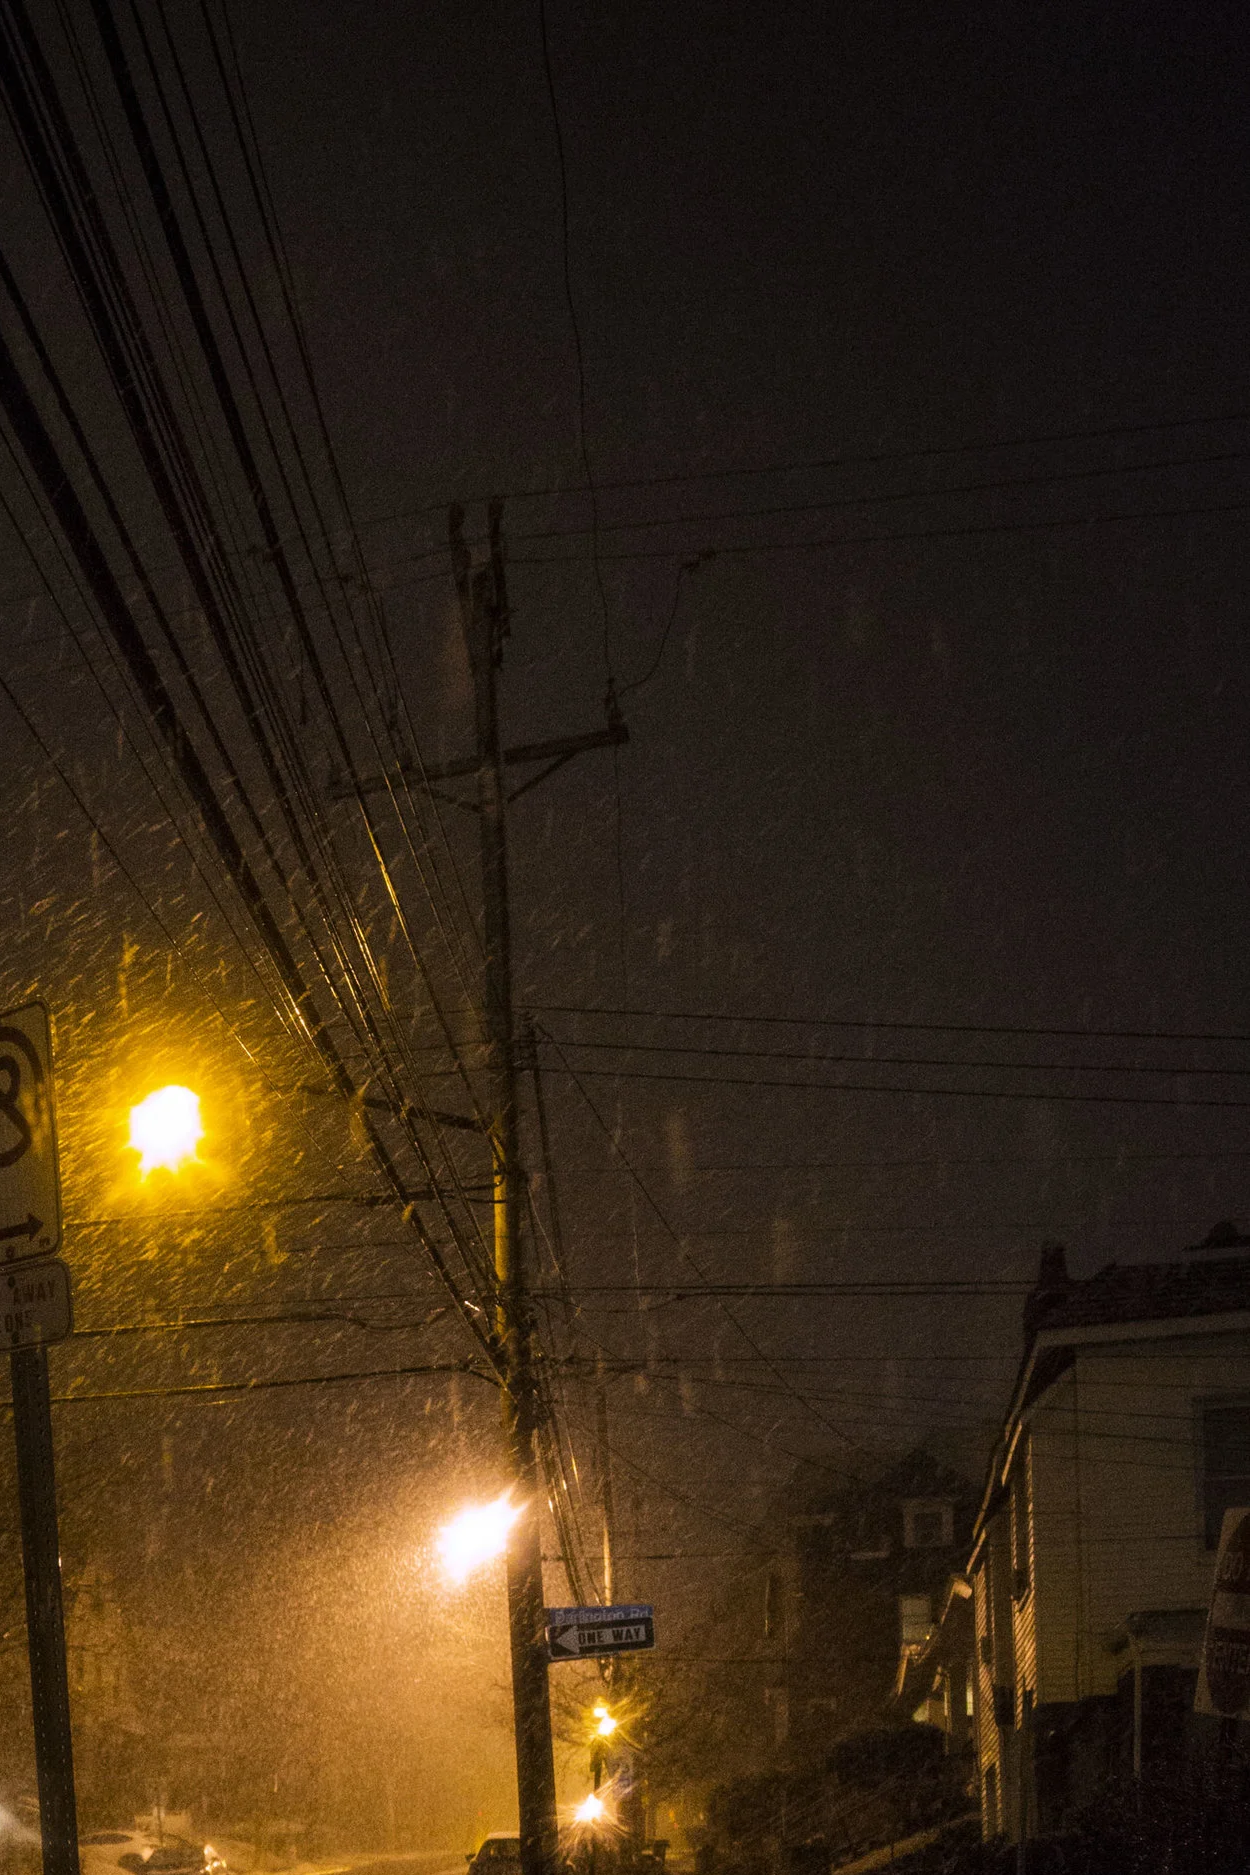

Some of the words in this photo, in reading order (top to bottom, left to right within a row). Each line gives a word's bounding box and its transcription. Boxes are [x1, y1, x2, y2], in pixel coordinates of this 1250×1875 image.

[13, 1280, 56, 1306] AWAY
[578, 1632, 604, 1645] ONE
[612, 1627, 640, 1642] WAY
[1206, 1641, 1250, 1675] ENTE
